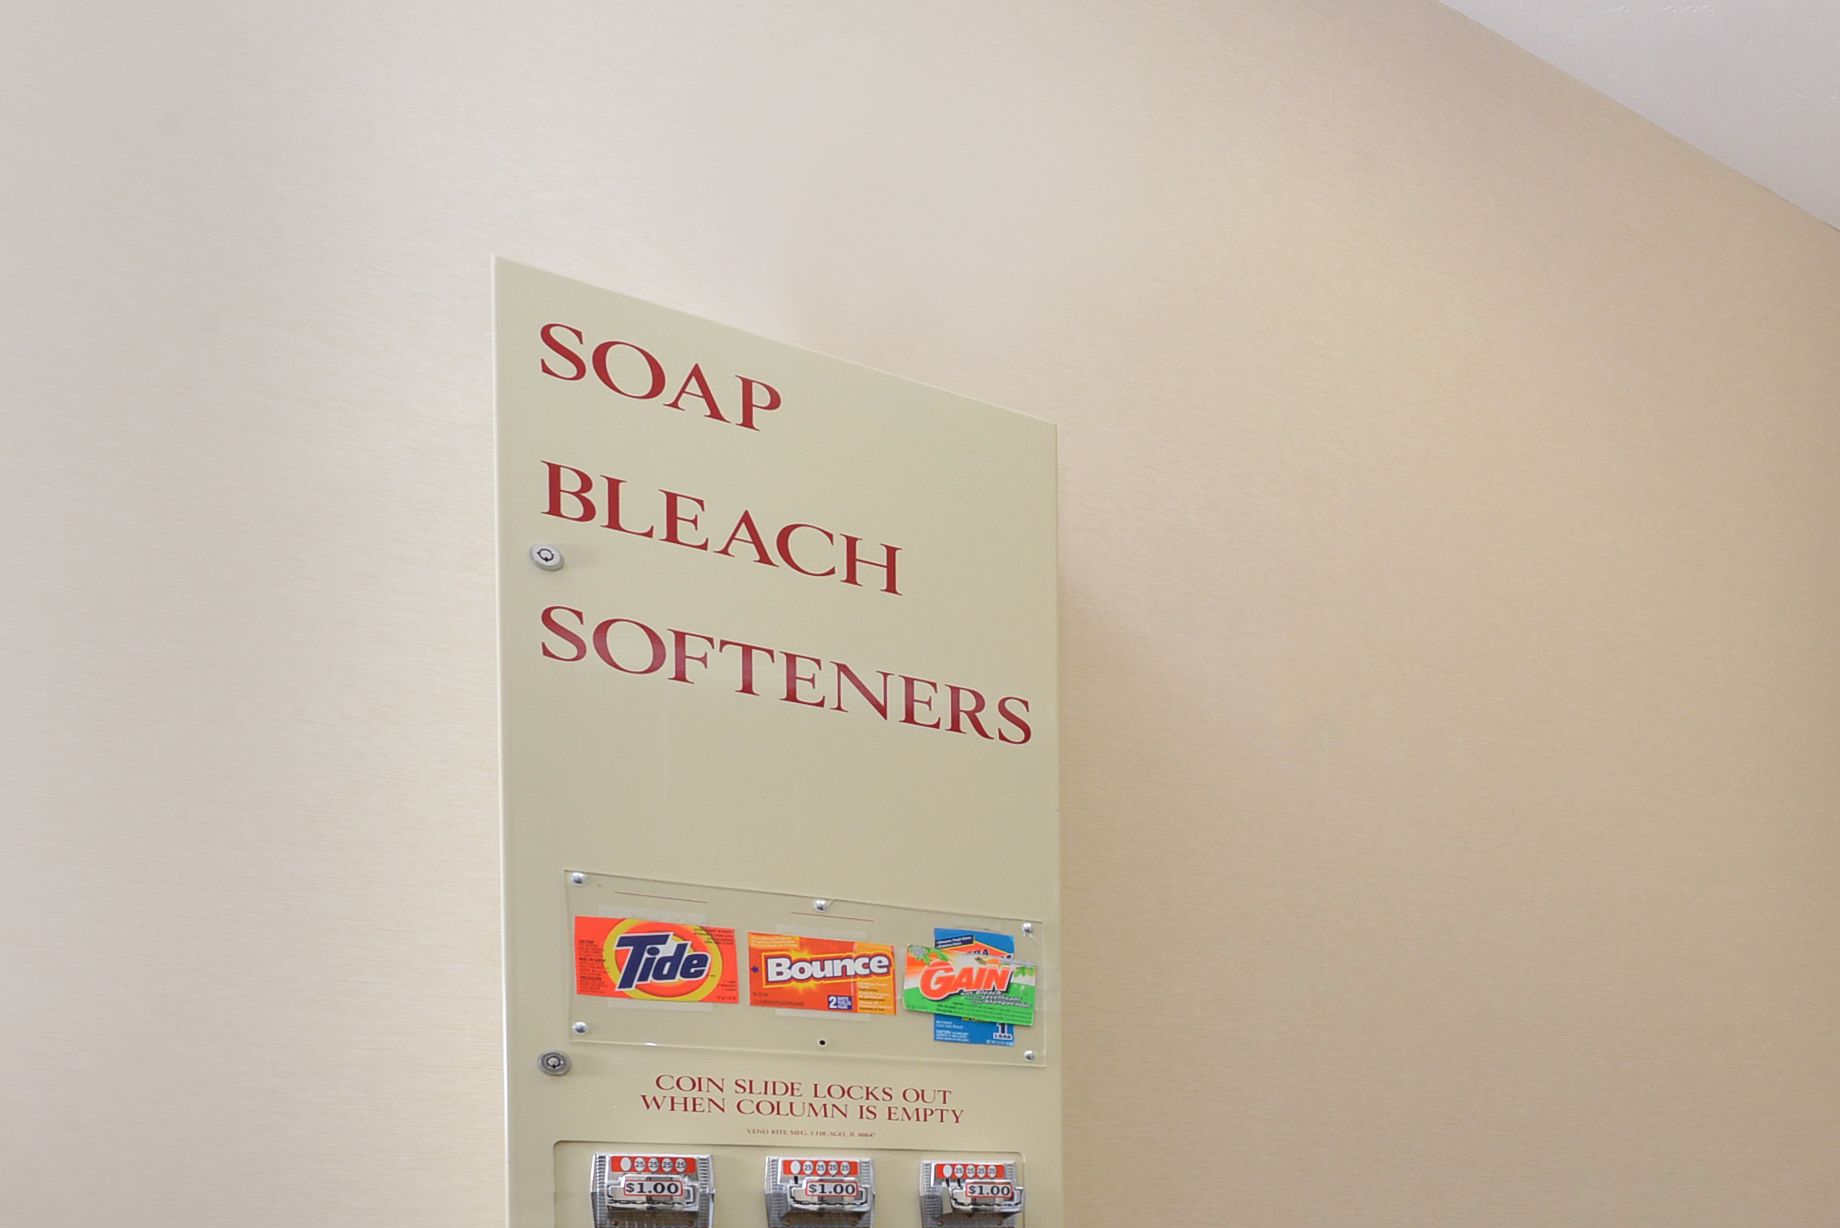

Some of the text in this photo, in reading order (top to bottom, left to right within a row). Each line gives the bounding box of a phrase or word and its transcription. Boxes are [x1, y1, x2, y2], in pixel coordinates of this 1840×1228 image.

[540, 322, 782, 431] SOAP
[541, 460, 904, 597] BLEACH
[541, 605, 1033, 745] SOFTENERS
[615, 932, 711, 991] Tide
[767, 955, 889, 982] Bounce
[920, 960, 1013, 1000] GAIN
[828, 996, 838, 1009] 2
[655, 1074, 951, 1105] COIN SLIDE LOCKS OUT
[640, 1094, 965, 1124] WHEN COLUMN IS EMPTY
[676, 1161, 685, 1169] 25
[625, 1182, 679, 1195] $1.00
[808, 1184, 856, 1195] $1.00
[968, 1185, 1011, 1196] $1.00
